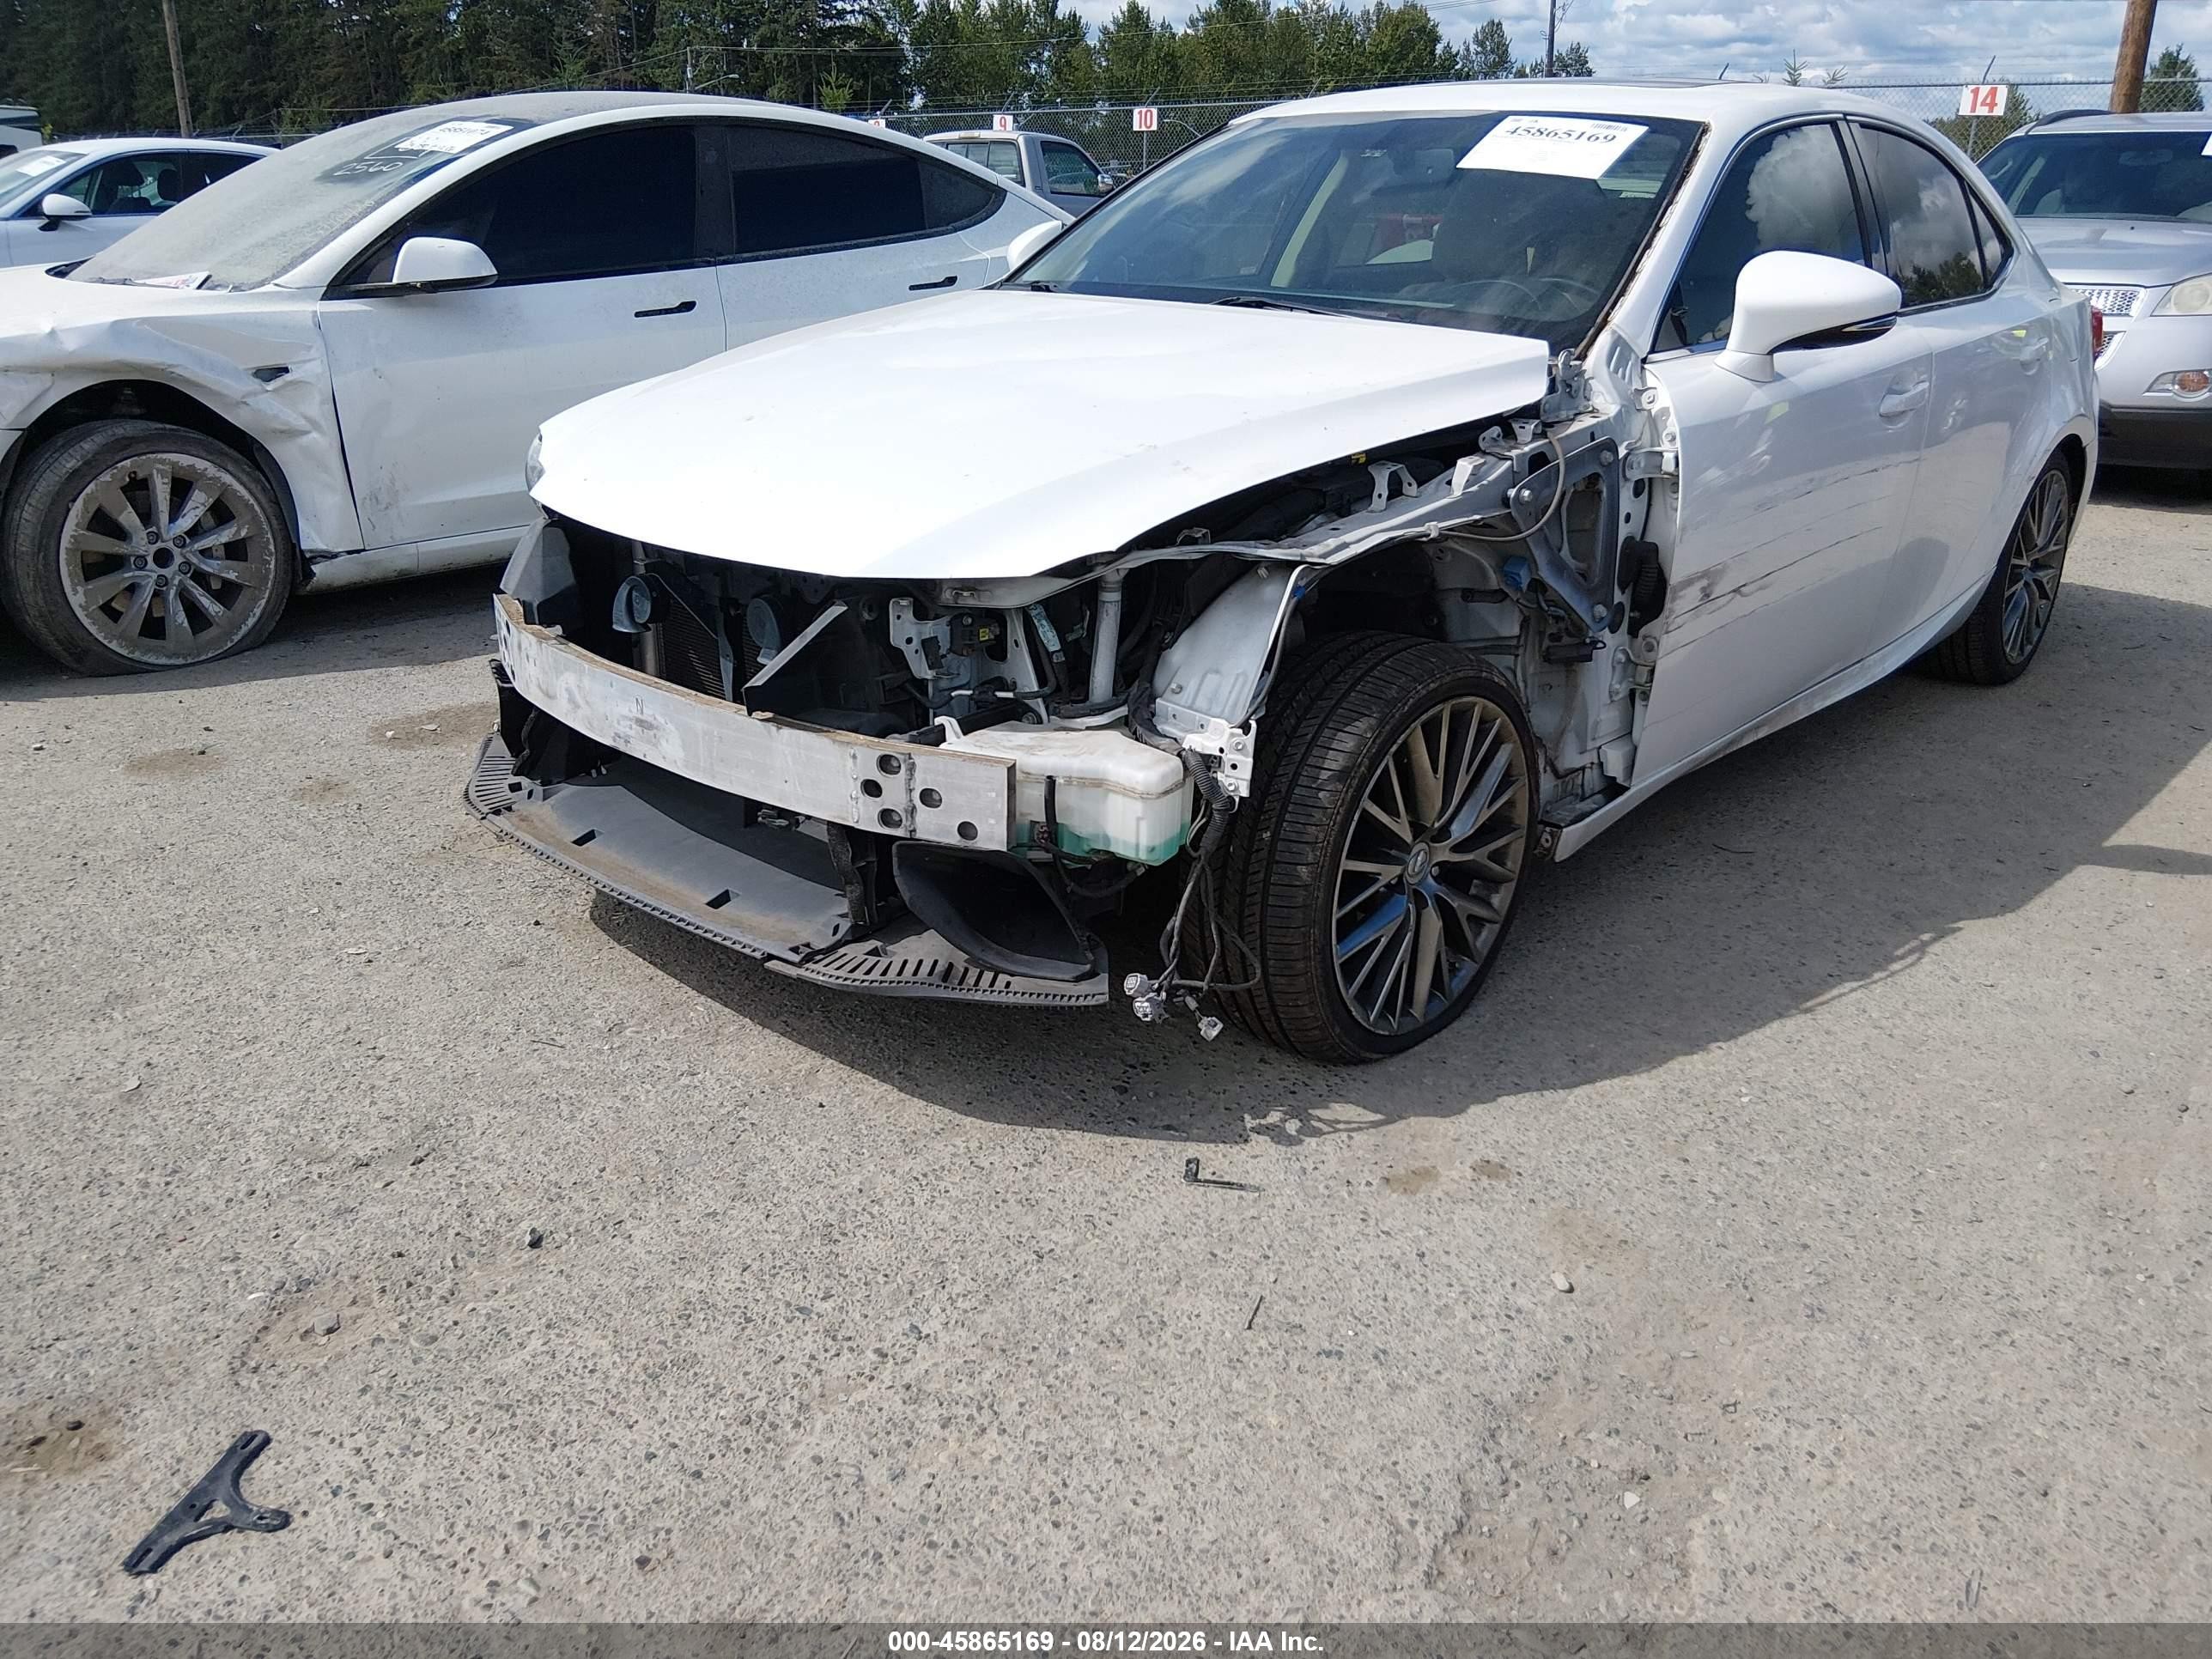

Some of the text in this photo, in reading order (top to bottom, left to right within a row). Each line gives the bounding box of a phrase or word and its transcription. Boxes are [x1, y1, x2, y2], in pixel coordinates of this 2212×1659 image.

[1969, 86, 1998, 113] 14
[999, 116, 1007, 131] 9
[1137, 109, 1153, 130] 10
[1505, 125, 1617, 144] 45865169
[332, 161, 404, 176] 2560
